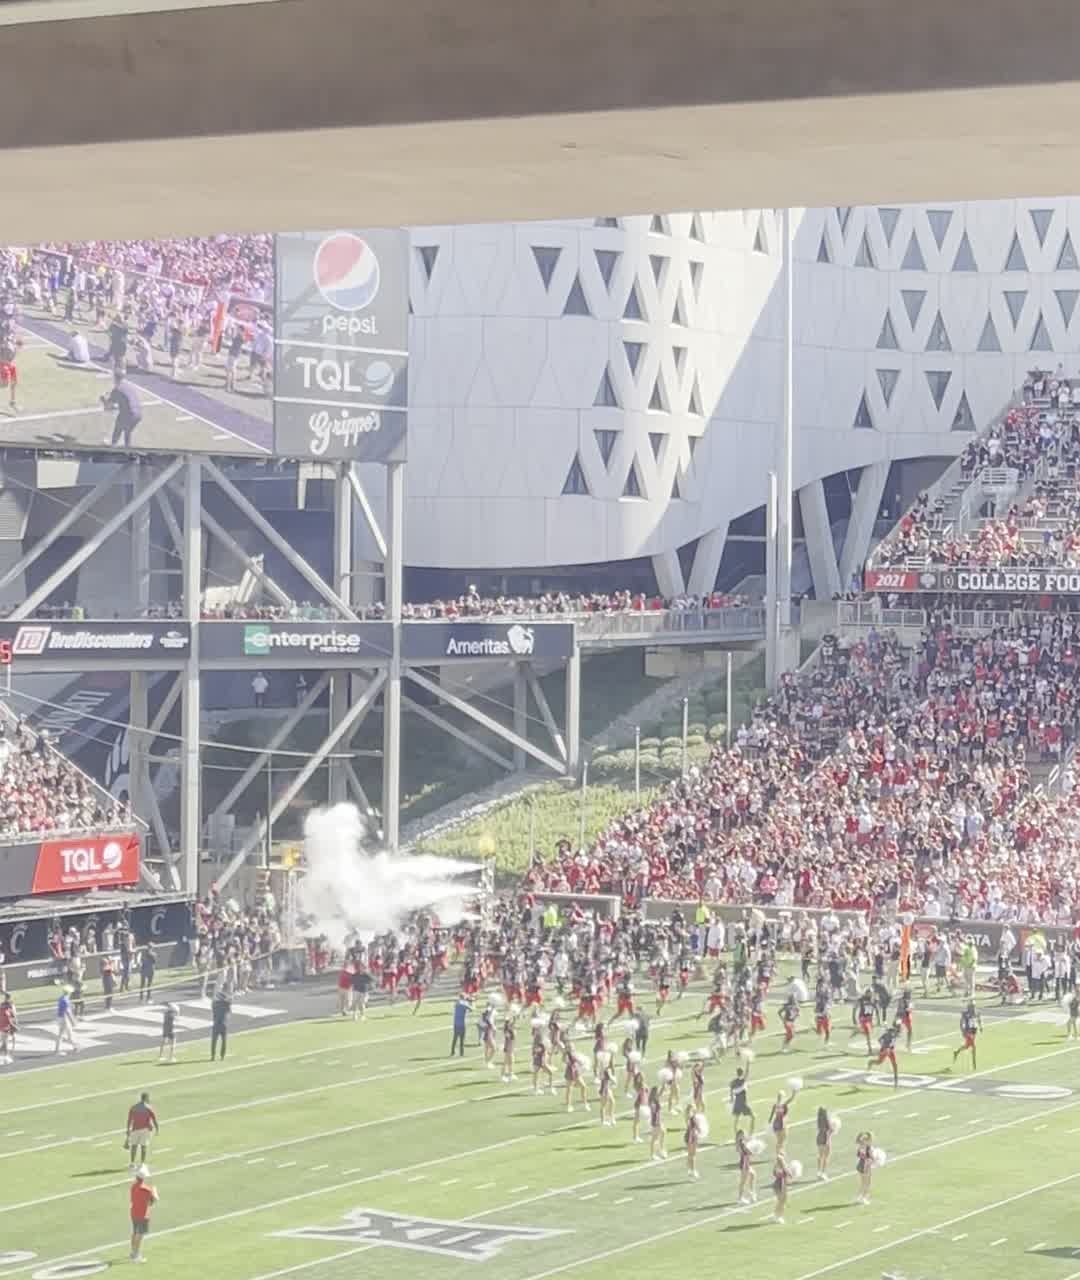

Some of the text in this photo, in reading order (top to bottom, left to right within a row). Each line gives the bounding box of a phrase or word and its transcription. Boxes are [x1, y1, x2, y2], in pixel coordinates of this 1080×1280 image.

[322, 314, 377, 336] pepsi
[296, 357, 362, 392] TQL
[875, 572, 905, 586] 2021
[958, 573, 1040, 591] COLLEGE
[252, 630, 360, 652] enterprise
[447, 637, 509, 655] Ameritas
[60, 848, 102, 873] TQL
